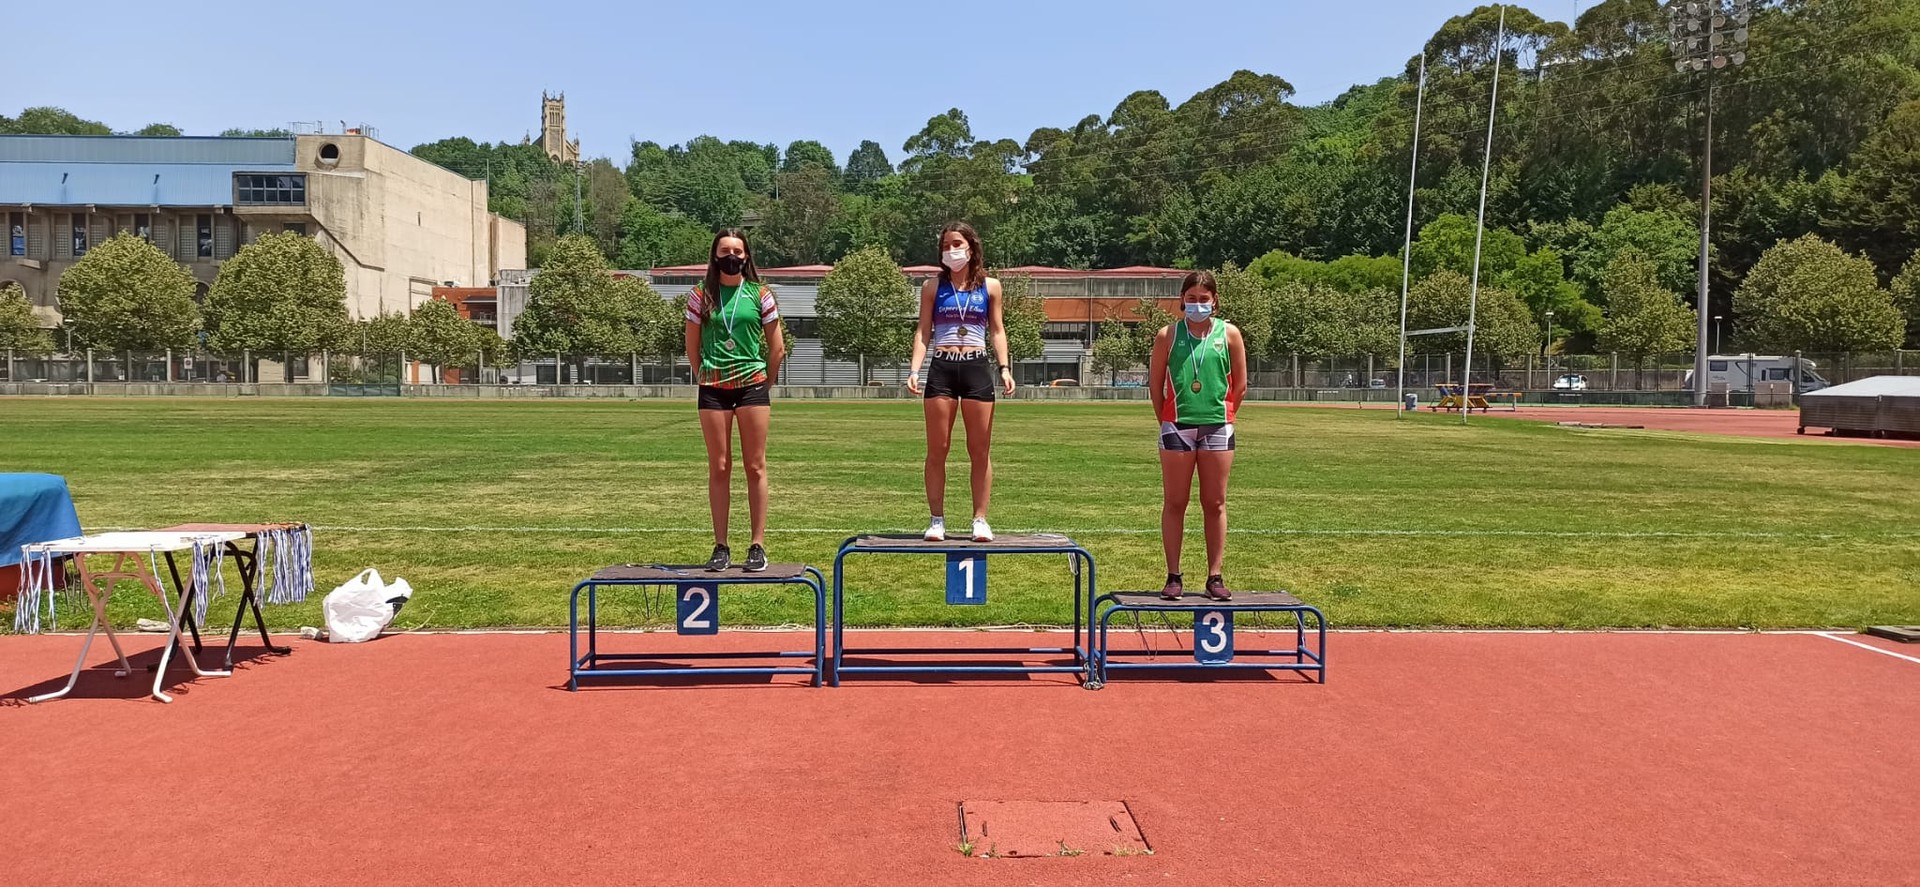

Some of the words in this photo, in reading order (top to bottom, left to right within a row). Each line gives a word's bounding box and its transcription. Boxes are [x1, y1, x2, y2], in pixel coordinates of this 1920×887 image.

[946, 351, 974, 361] NIKE
[958, 557, 974, 598] 1
[683, 586, 710, 628] 2
[1200, 611, 1227, 653] 3
